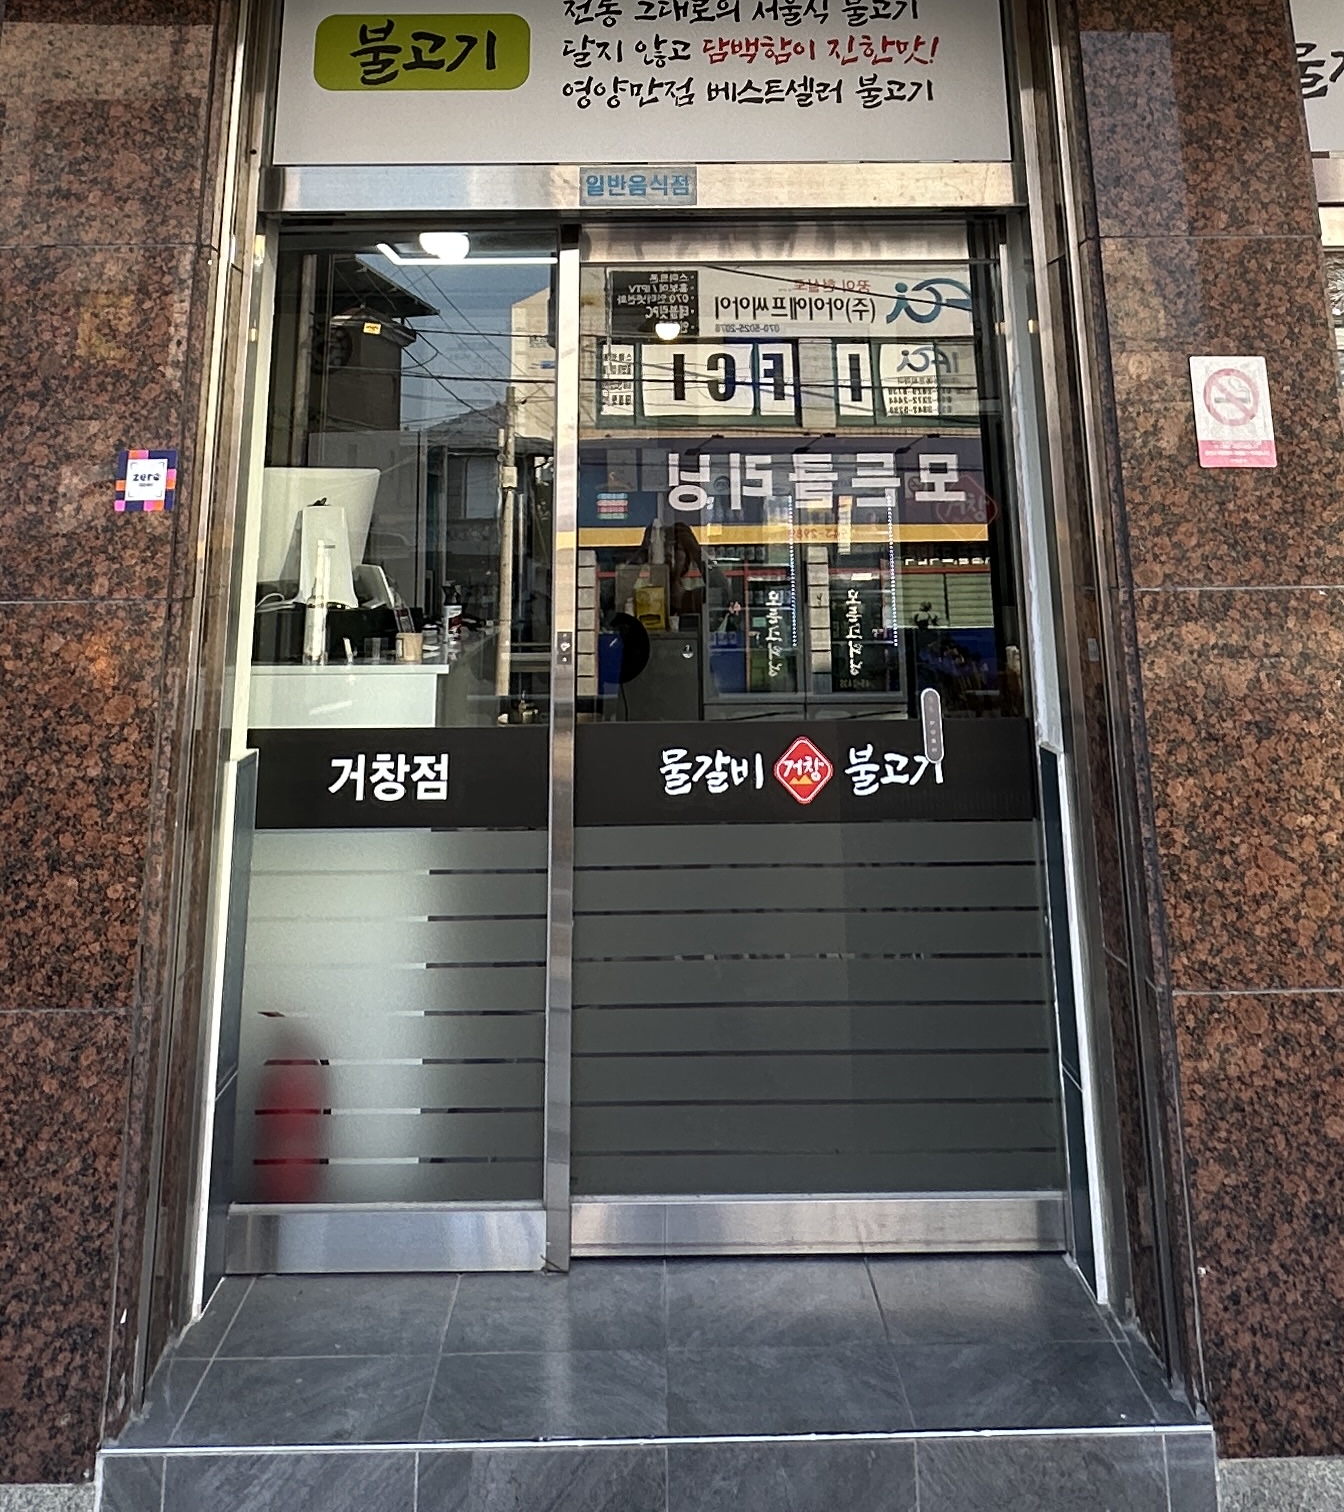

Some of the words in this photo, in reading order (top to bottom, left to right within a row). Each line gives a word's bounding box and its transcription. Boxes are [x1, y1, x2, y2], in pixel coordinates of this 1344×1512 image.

[350, 19, 497, 86] 불고기
[563, 35, 623, 68] 달지
[635, 37, 691, 68] 않고
[702, 36, 816, 64] 담백함이
[827, 36, 939, 66] 진한맛!
[563, 76, 695, 108] 영양만점
[707, 75, 843, 106] 베스트셀러
[856, 74, 933, 107] 불고기
[585, 173, 690, 199] 일반음식점
[327, 754, 451, 802] 거창점
[659, 748, 764, 796] 물갈비
[781, 755, 826, 784] 거창
[844, 743, 945, 796] 불고기
